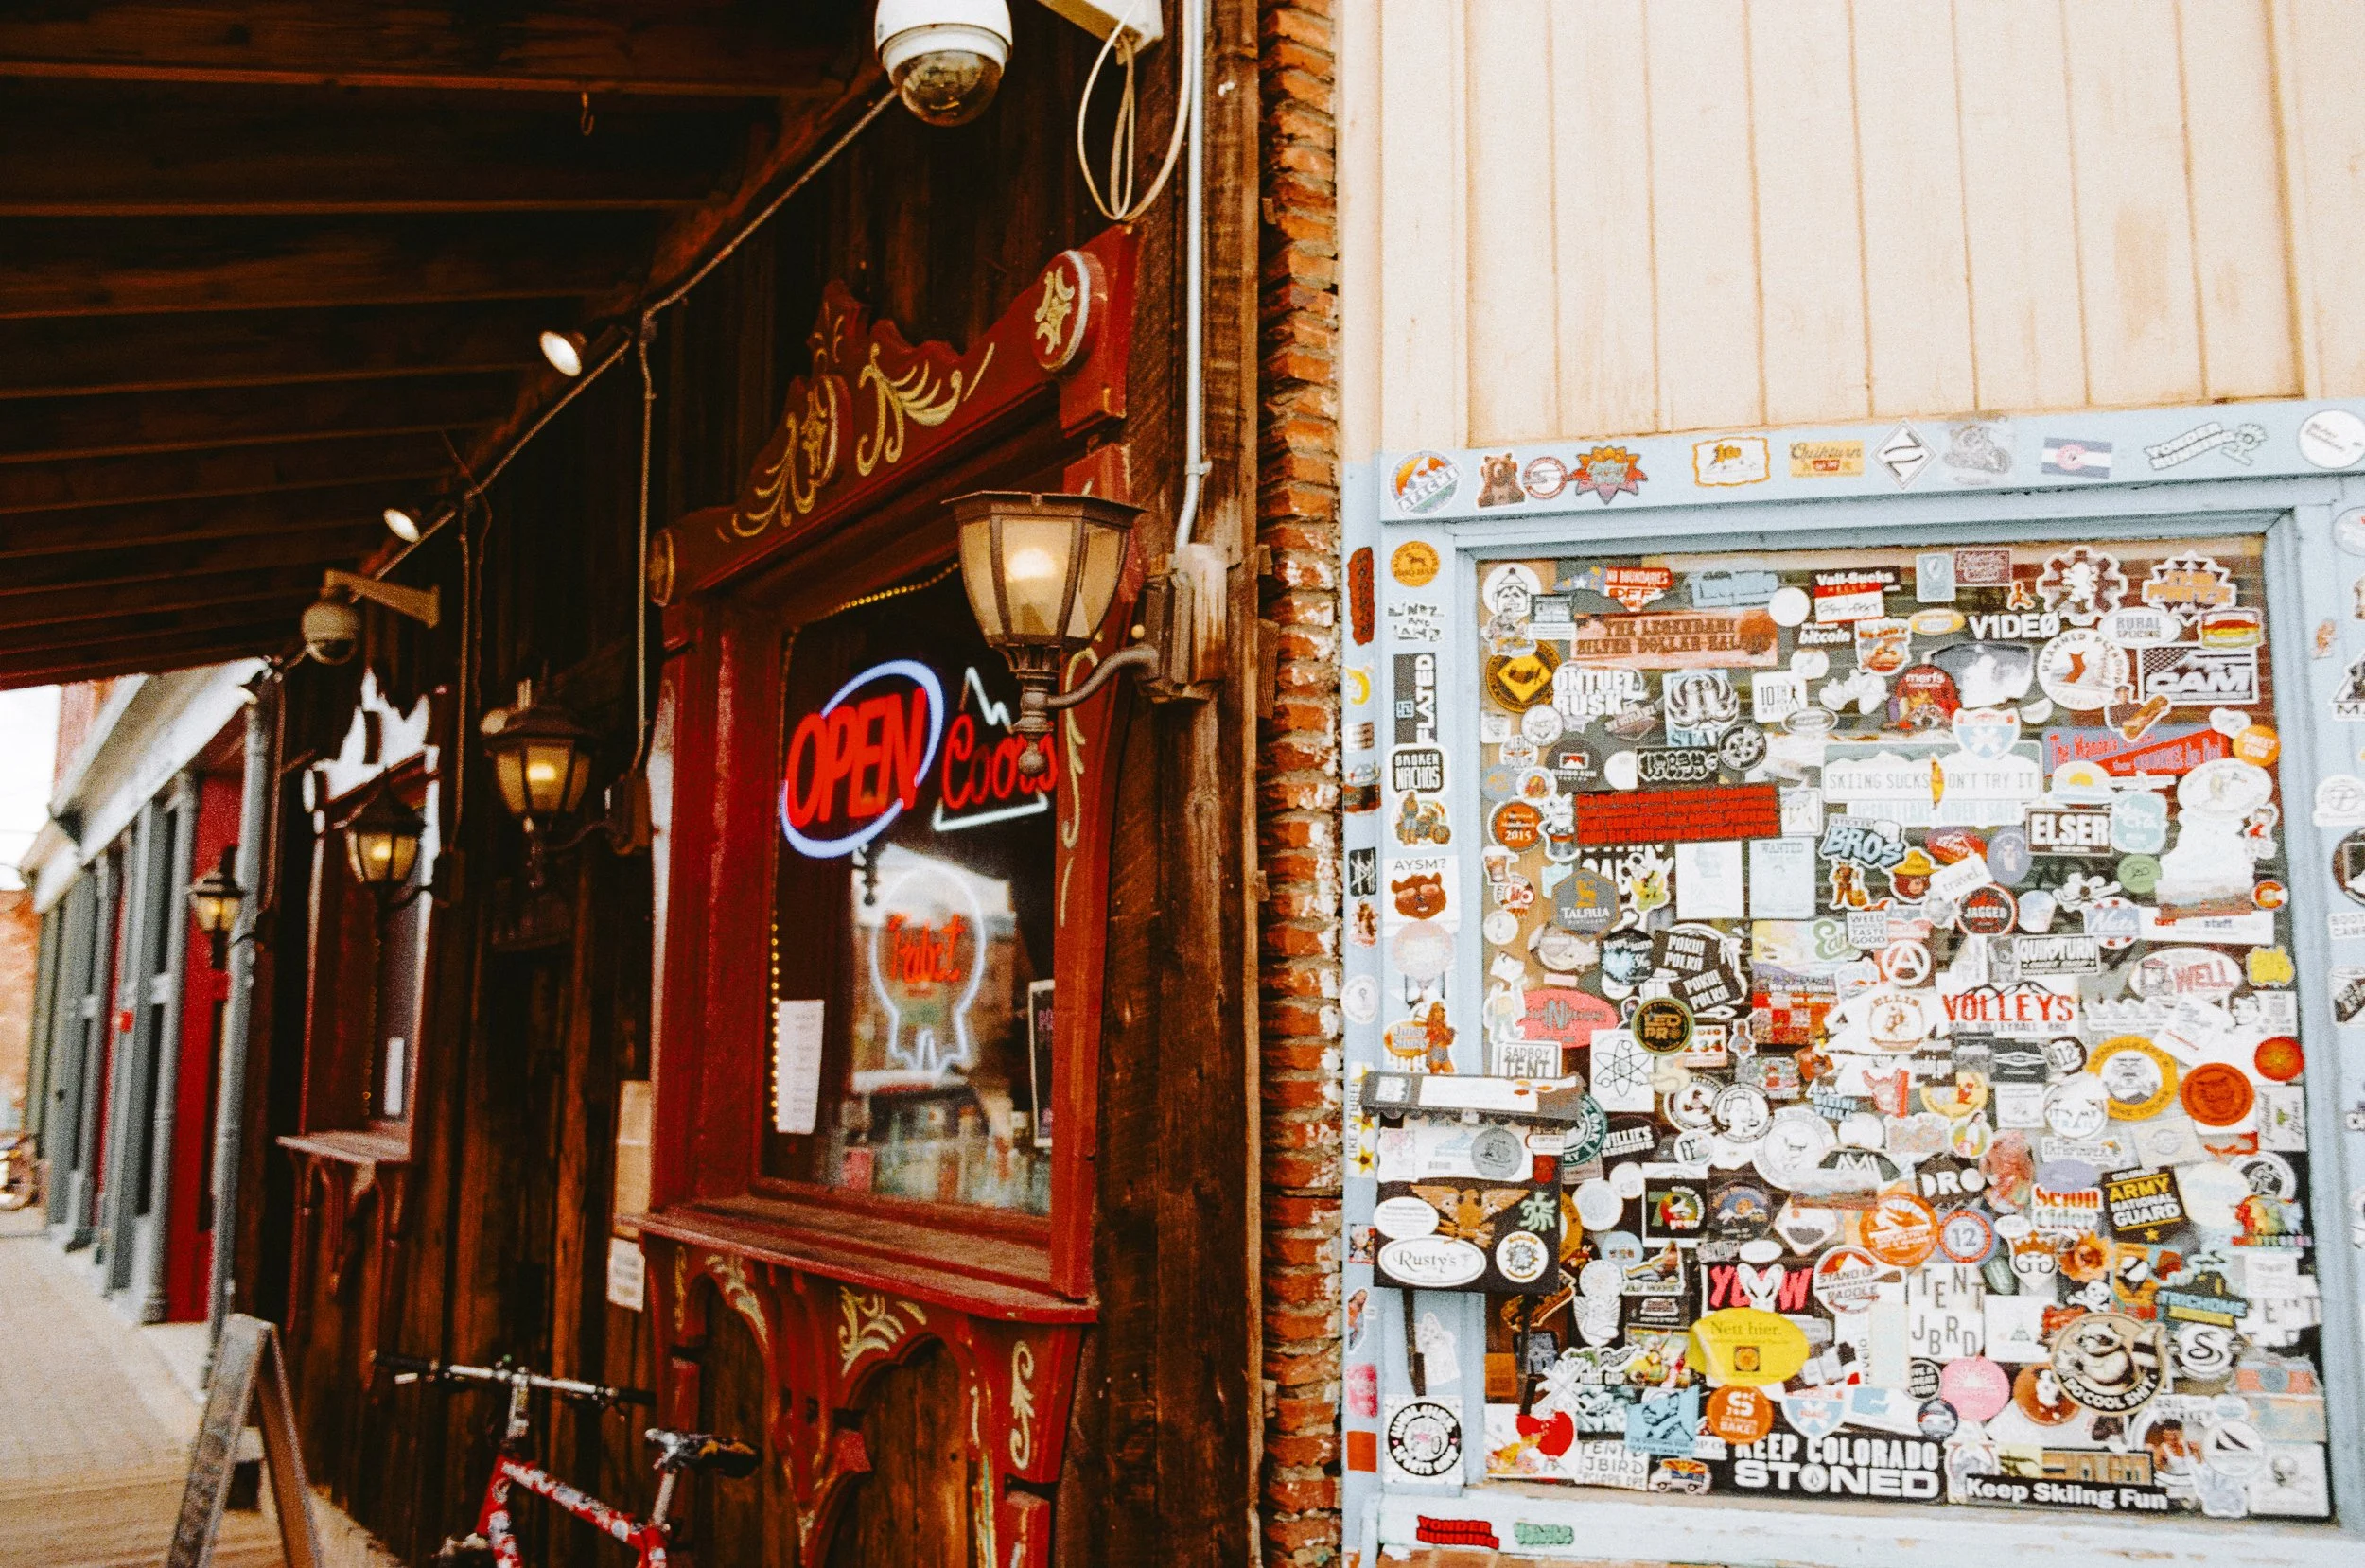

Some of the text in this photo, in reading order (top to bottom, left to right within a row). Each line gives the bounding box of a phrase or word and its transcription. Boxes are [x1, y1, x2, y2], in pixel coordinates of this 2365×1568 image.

[2146, 423, 2222, 457] YONDER
[2151, 430, 2235, 469] RUNNING
[2116, 617, 2161, 629] RURAL
[1638, 636, 1702, 654] DOLLAR
[1799, 629, 1852, 645] bitcoin
[2041, 632, 2087, 671] PLANNED
[2146, 672, 2250, 693] CAM
[785, 688, 925, 828] OPEN
[1395, 754, 1439, 765] BROKEN
[1396, 768, 1440, 789] NACHOS
[1829, 772, 1882, 789] SKIING
[1886, 772, 1930, 789] SUCKS
[1985, 772, 2013, 789] TRY
[2018, 772, 2035, 787] IT
[1505, 830, 1532, 841] 2015
[2032, 815, 2109, 845] ELSER
[1761, 842, 1803, 853] WANTED
[1824, 827, 1903, 866] BROS
[1393, 858, 1446, 871] AYSM?
[1851, 928, 1884, 936] TASTE
[1664, 952, 1703, 970] POLKA
[2173, 959, 2234, 993] WELL
[1689, 984, 1731, 1011] POLKA
[1941, 994, 2075, 1021] VOLLEYS
[1505, 1047, 1550, 1059] SADBOY
[1504, 1057, 1550, 1077] TENT
[1350, 1122, 1358, 1133] A
[1349, 1133, 1359, 1159] LIKE
[2110, 1178, 2169, 1201] ARMY
[2111, 1193, 2176, 1211] NATIONAL
[2114, 1205, 2181, 1227] GUARD
[1951, 1228, 1977, 1247] 12
[1393, 1250, 1457, 1274] Rusty's
[1818, 1269, 1861, 1283] STAND
[1827, 1284, 1878, 1300] PADDLE
[2159, 1292, 2246, 1315] TRICHOME
[1710, 1320, 1782, 1335] Nett hier.
[1909, 1385, 1936, 1396] STORY
[2083, 1393, 2126, 1410] COOL
[2125, 1375, 2159, 1405] SHIT
[1807, 1437, 1939, 1470] COLORADO
[1735, 1460, 1939, 1498] STONED
[1966, 1477, 2168, 1510] Keep Skiing Fun
[1418, 1517, 1491, 1532] YONDER
[1417, 1529, 1499, 1549] RUNNING
